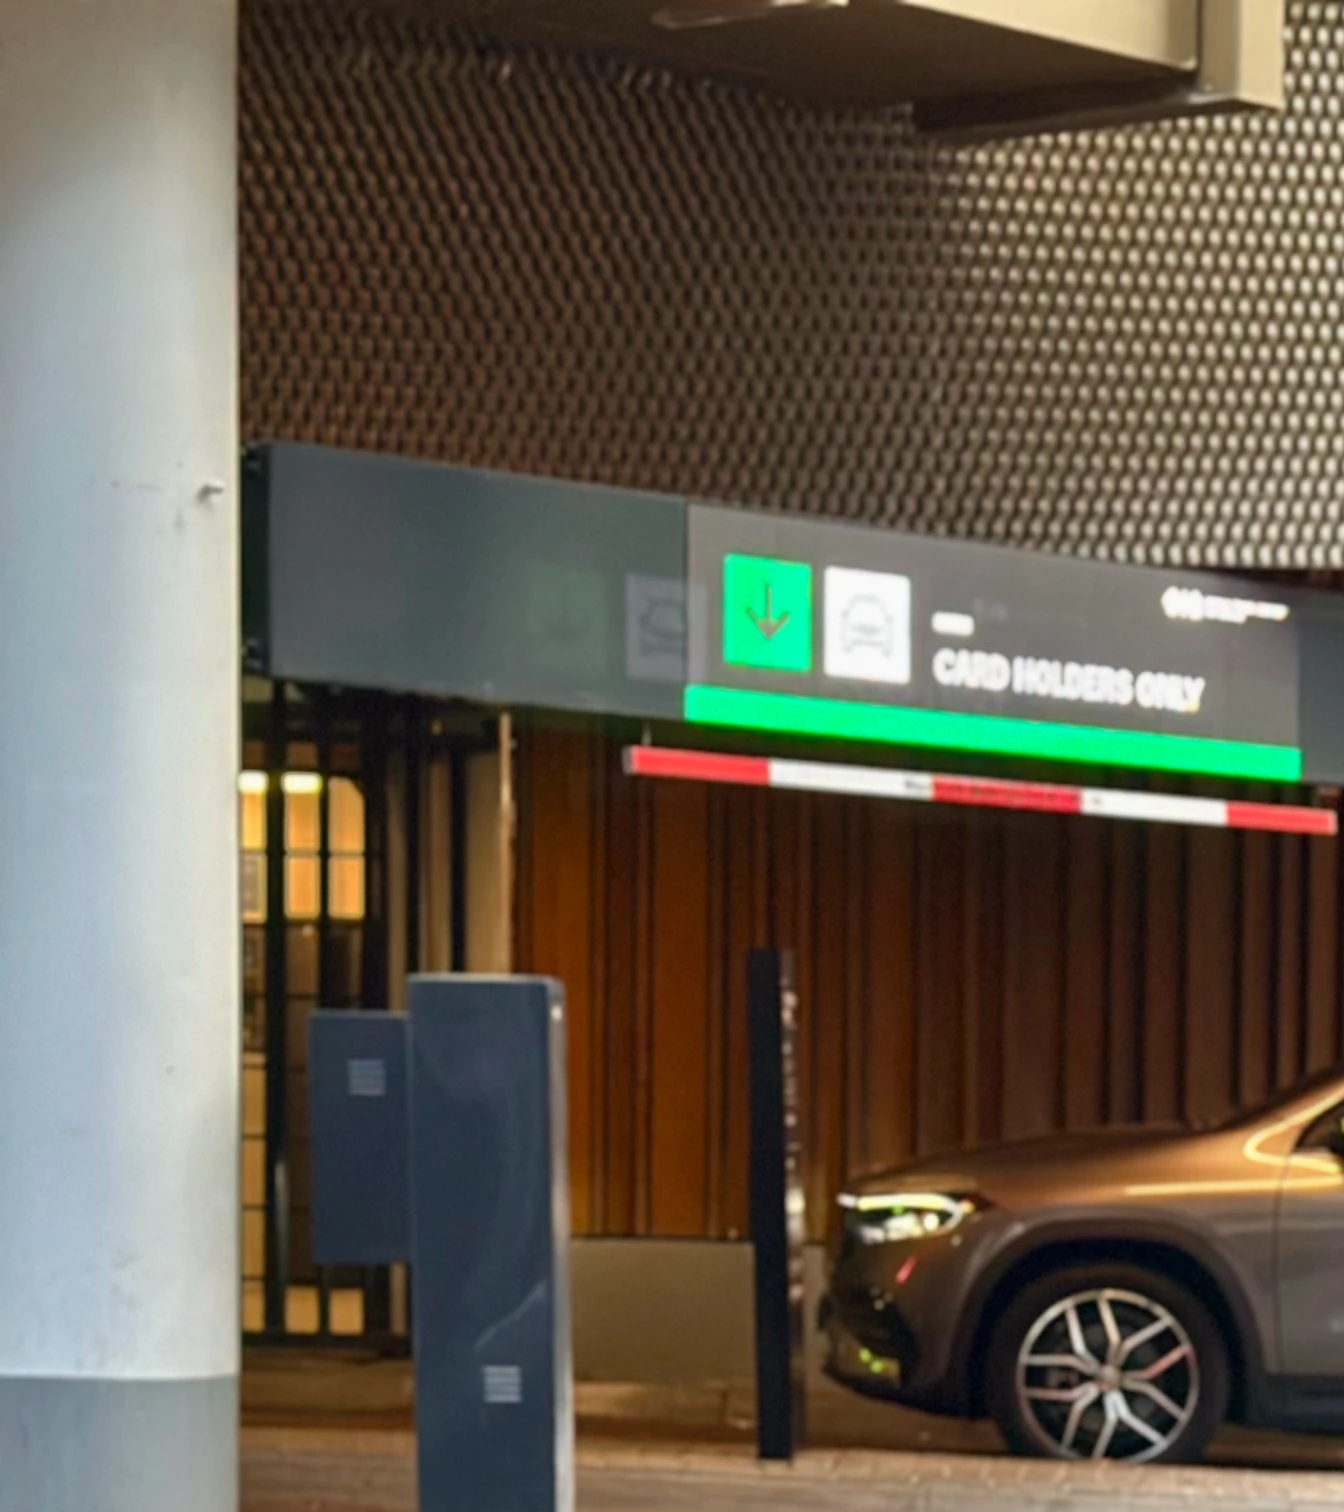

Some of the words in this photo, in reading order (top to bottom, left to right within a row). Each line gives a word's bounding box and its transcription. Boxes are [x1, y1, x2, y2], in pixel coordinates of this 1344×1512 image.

[933, 649, 1010, 690] CARD
[1013, 656, 1134, 705] HOLDERS
[1136, 671, 1205, 712] ONLY
